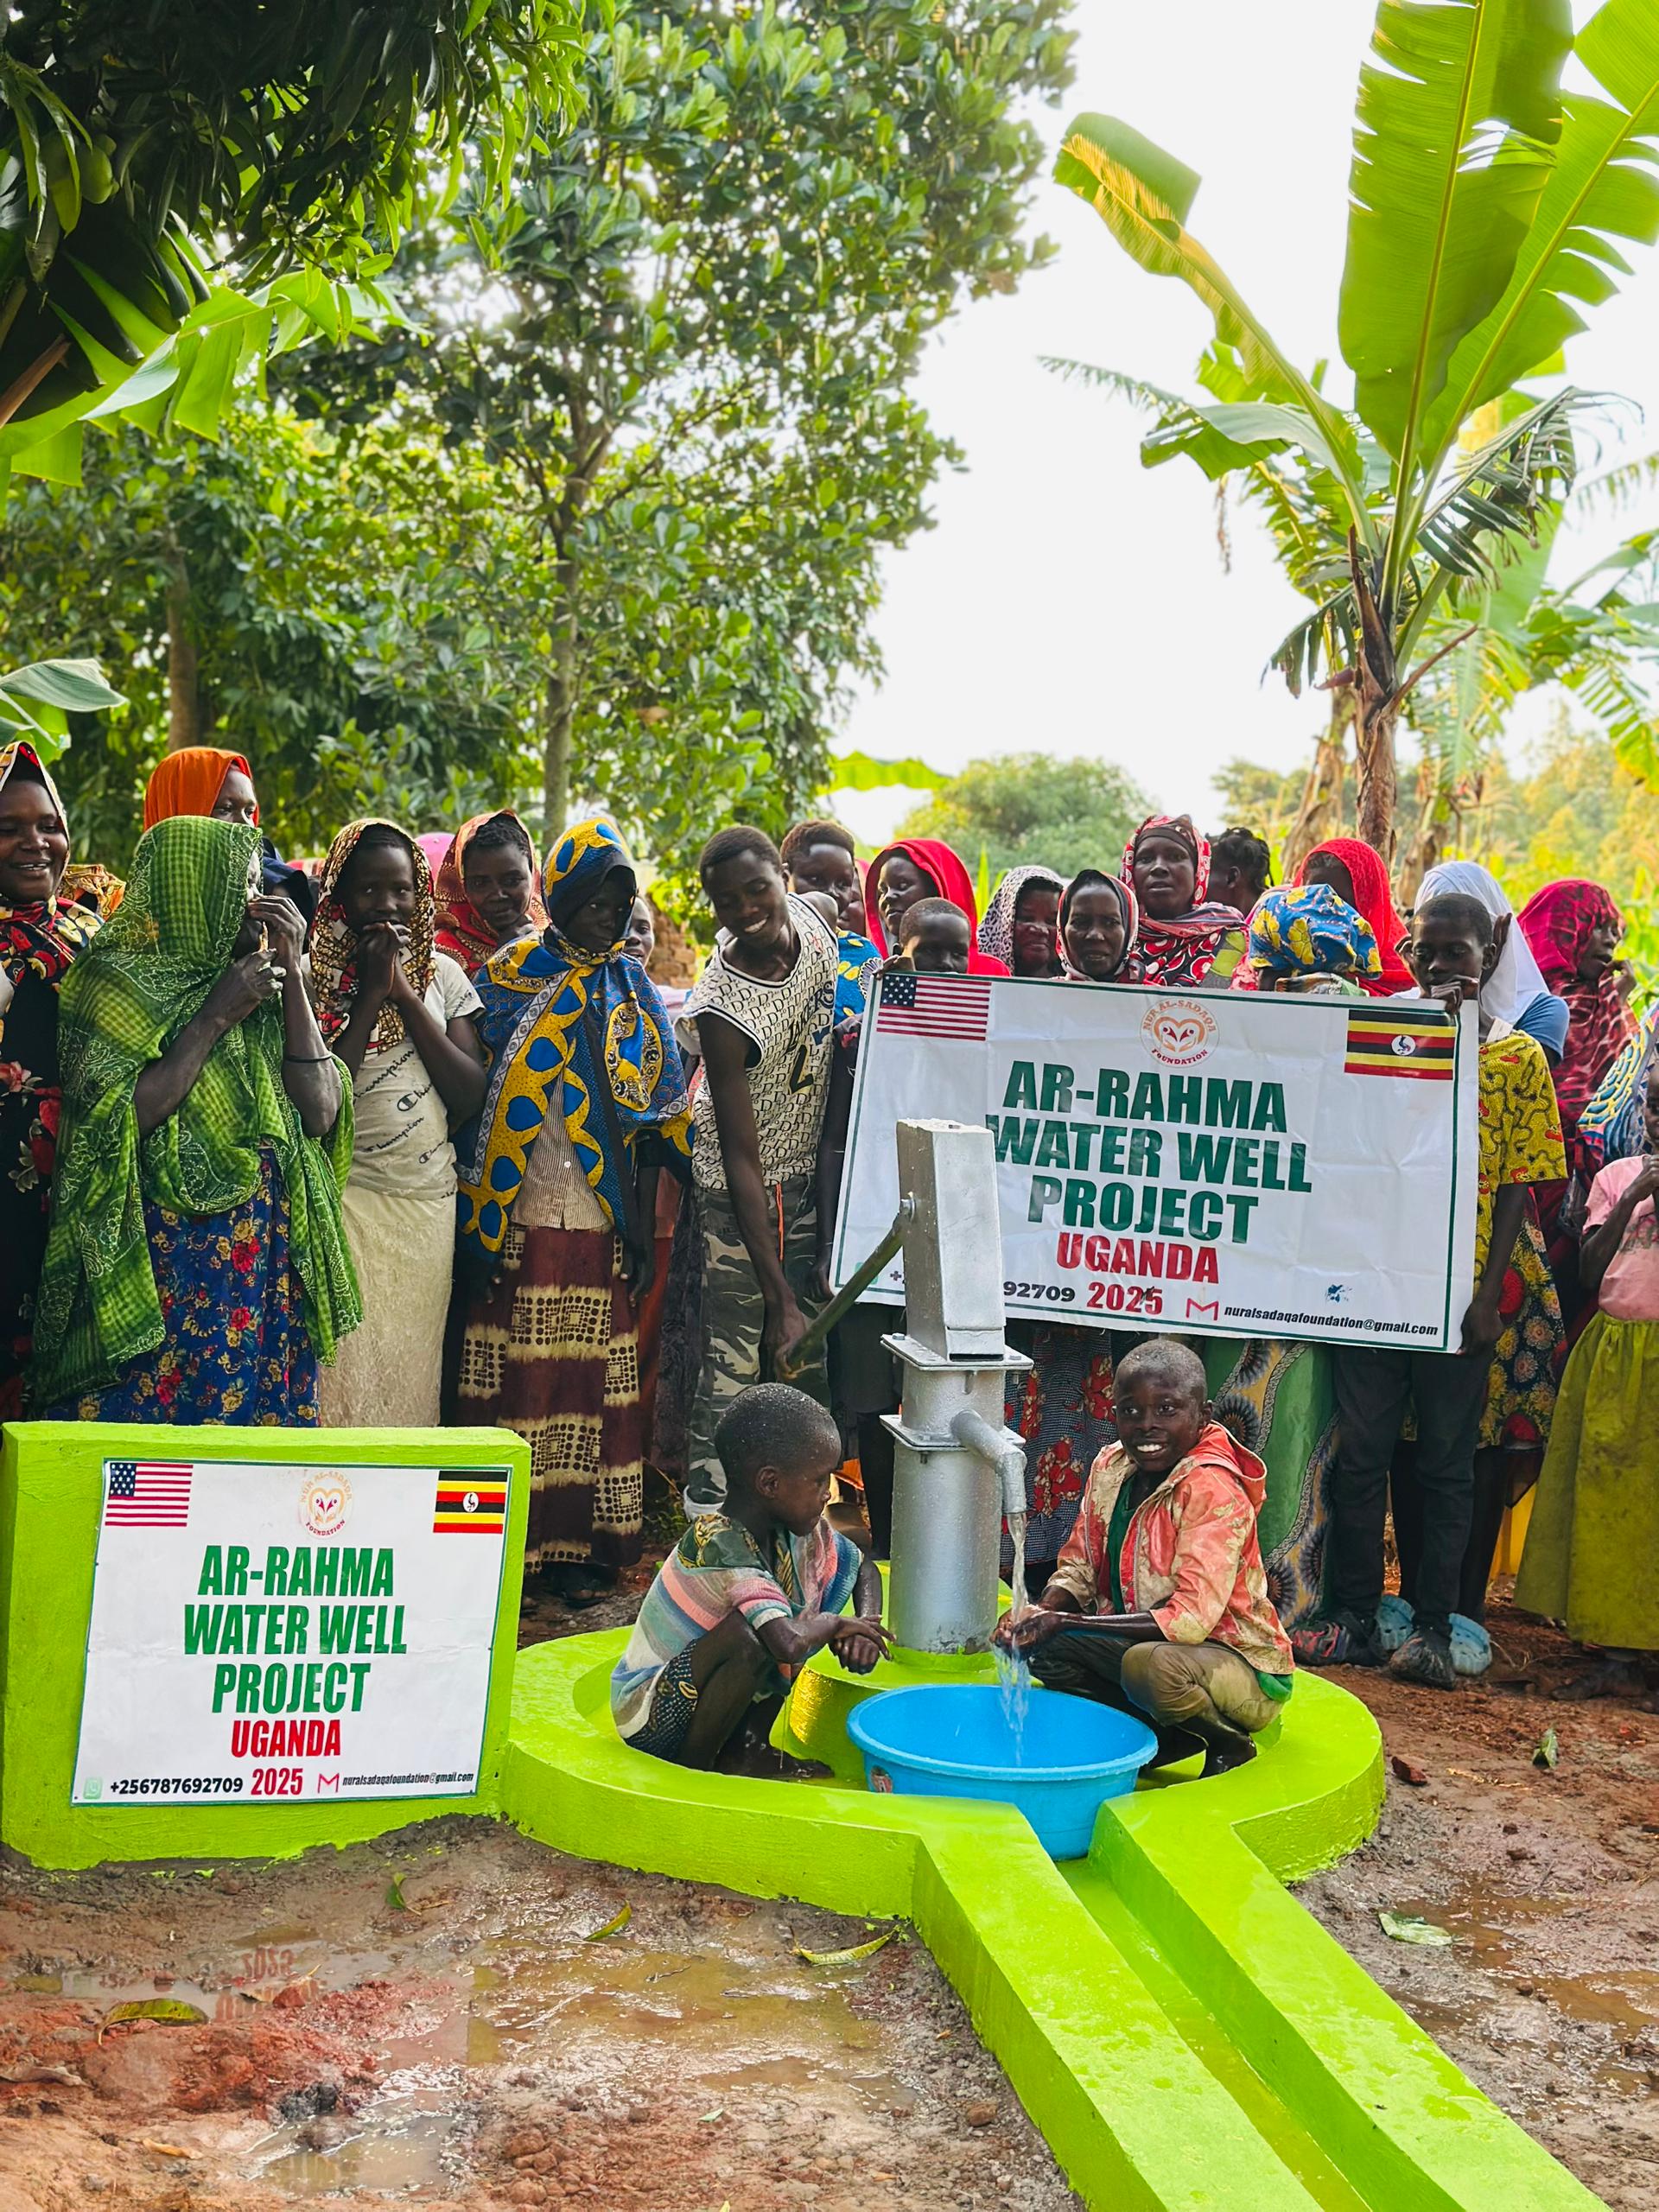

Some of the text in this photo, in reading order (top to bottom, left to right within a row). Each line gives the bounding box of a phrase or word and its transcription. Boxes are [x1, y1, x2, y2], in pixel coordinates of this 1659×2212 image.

[1159, 1000, 1217, 1033] AL-SADAQA
[353, 1048, 415, 1105] hampion
[1151, 1048, 1208, 1065] FOUNDATION
[1002, 1060, 1287, 1133] AR-RAHMA
[986, 1114, 1312, 1192] WATER WELL
[1027, 1174, 1258, 1243] PROJECT
[1056, 1232, 1219, 1283] UGANDA
[1086, 1281, 1163, 1315] 2025
[1224, 1306, 1439, 1336] nuralsadaqafoundation@gmail.com
[305, 1519, 346, 1536] FOUNDATION
[198, 1545, 394, 1597] AR-RAHMA
[184, 1604, 407, 1655] WATER WELL
[212, 1662, 372, 1714] PROJECT
[231, 1719, 341, 1758] UGANDA
[110, 1777, 244, 1795] +256787692709
[251, 1768, 303, 1796] 2025
[342, 1771, 474, 1786] nuralsadaqafoundation@gmail.com
